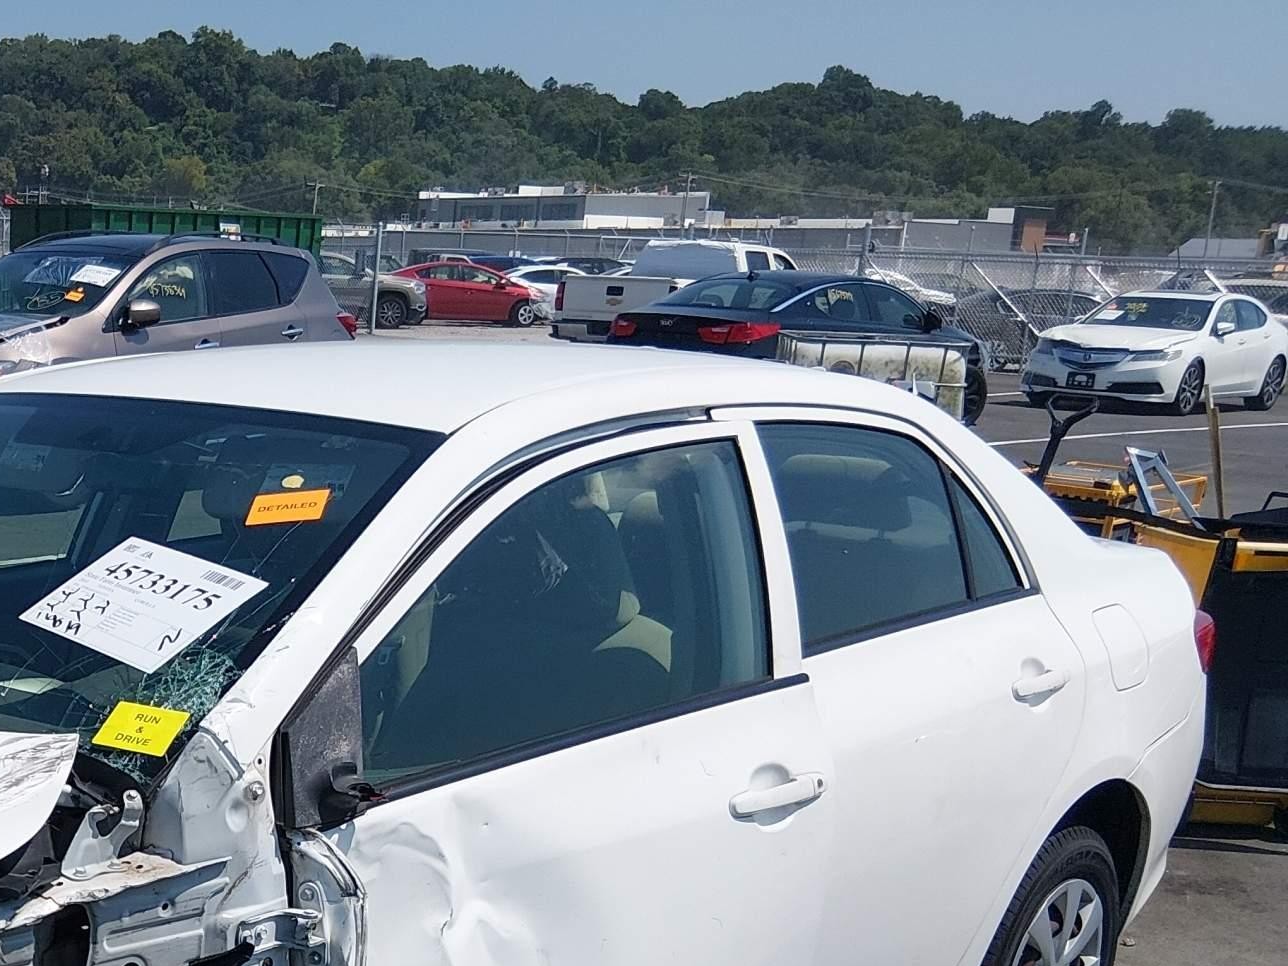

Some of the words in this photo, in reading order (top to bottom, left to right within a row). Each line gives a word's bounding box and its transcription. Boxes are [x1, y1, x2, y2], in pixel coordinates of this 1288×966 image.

[257, 502, 318, 513] DETAILED
[104, 561, 222, 611] 45733175
[134, 713, 162, 725] RUN
[135, 726, 144, 734] &
[115, 732, 152, 746] DRIVE
